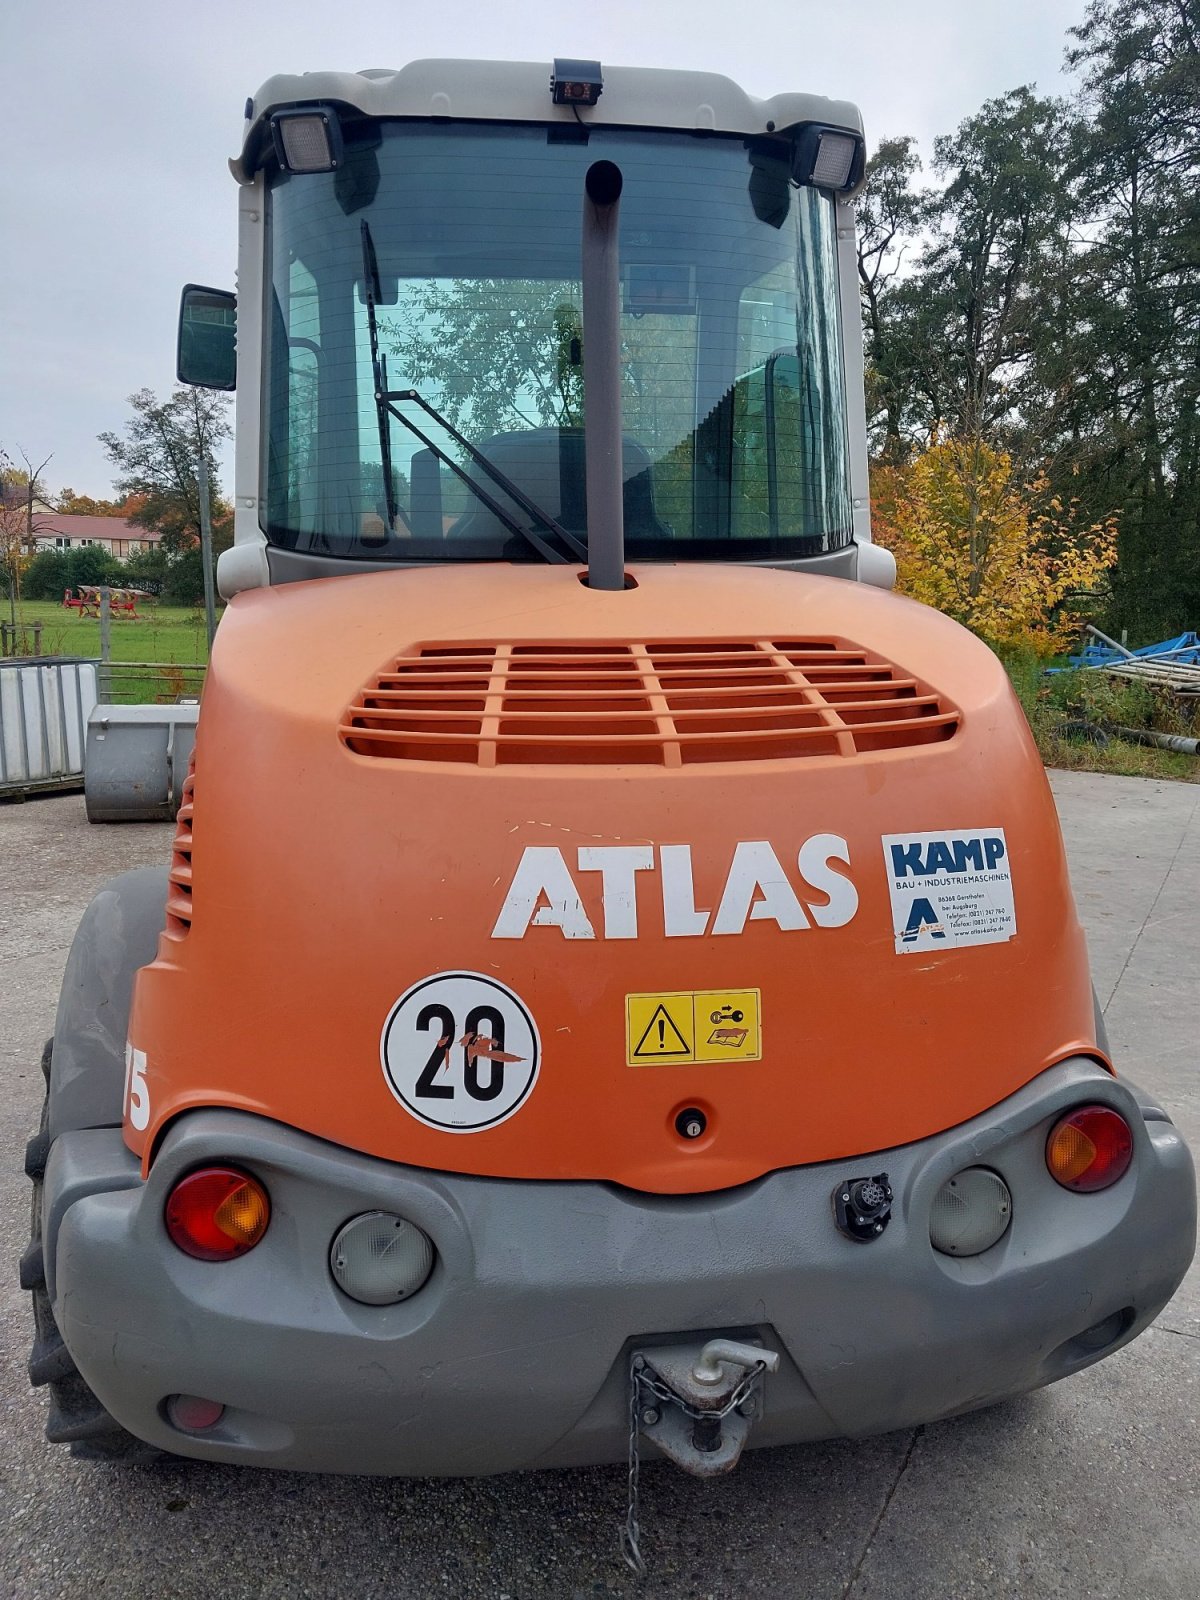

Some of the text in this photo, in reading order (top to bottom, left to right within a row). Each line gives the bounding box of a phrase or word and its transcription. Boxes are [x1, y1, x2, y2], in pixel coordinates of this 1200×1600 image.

[890, 838, 1005, 877] KAMP
[490, 833, 859, 940] ATLAS
[896, 881, 915, 890] BAU
[924, 873, 1009, 888] INDUSTRIEMASCHINEN
[952, 903, 978, 911] Augsburg
[957, 893, 985, 901] Gersthofen
[415, 1003, 506, 1102] 20
